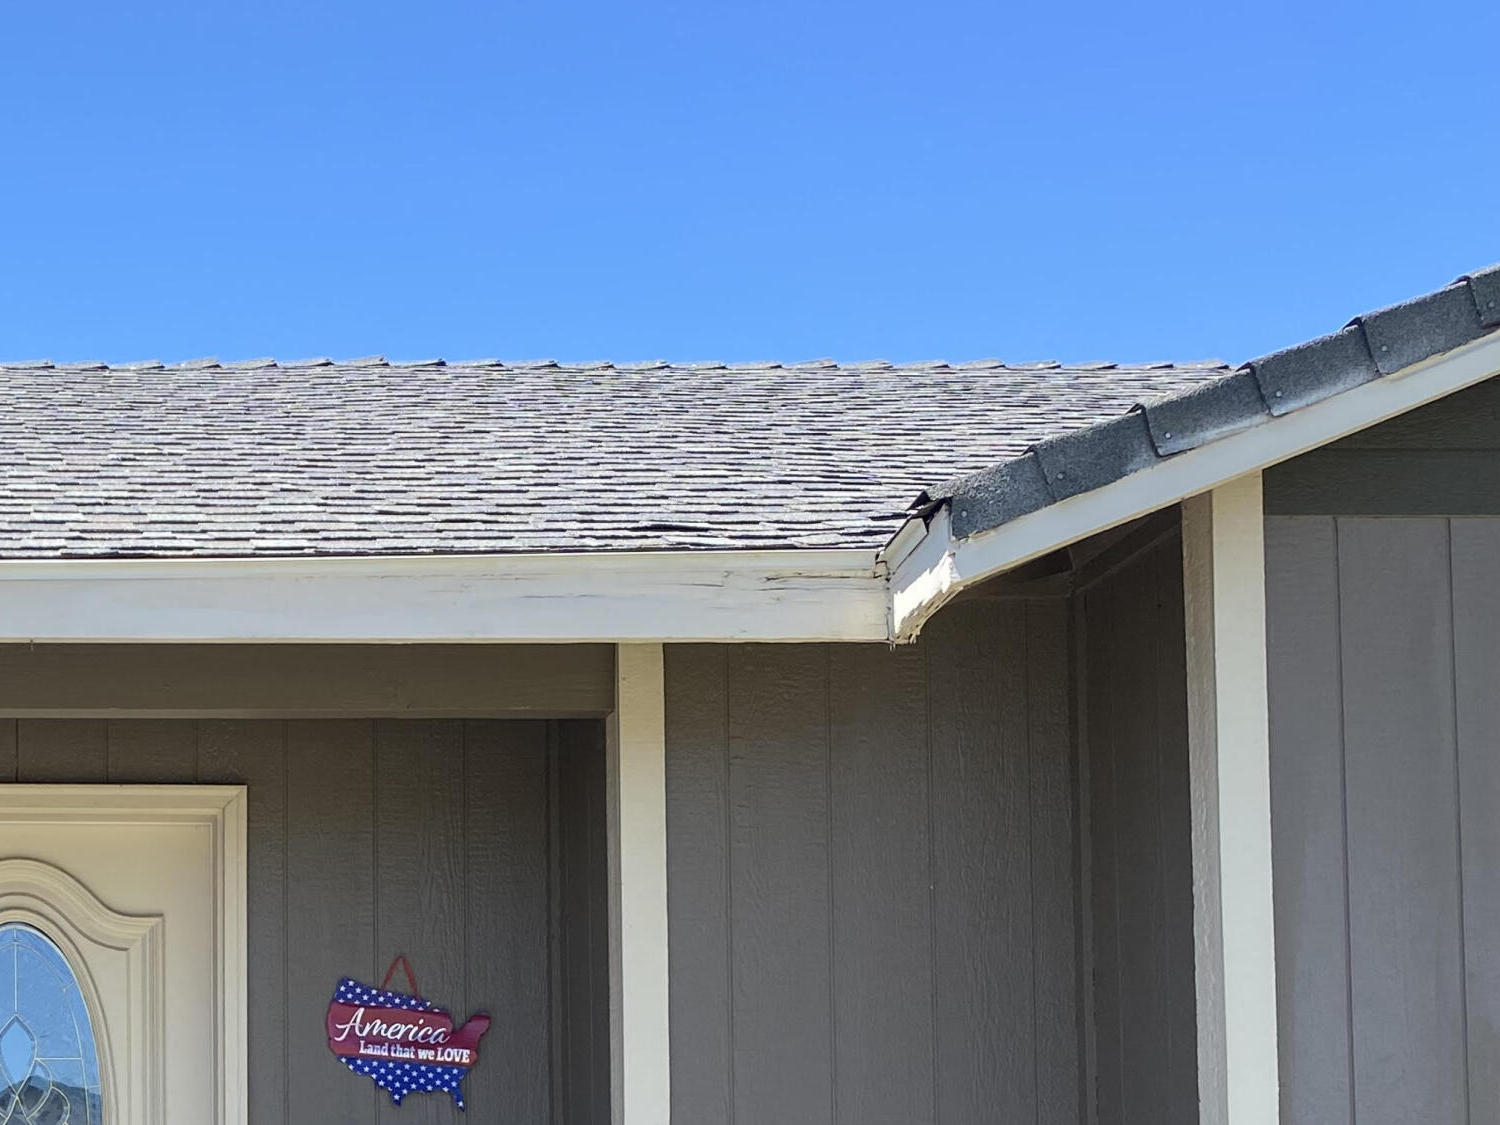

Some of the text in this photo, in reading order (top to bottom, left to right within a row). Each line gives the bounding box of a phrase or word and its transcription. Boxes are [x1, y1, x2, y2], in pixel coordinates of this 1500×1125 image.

[334, 1007, 450, 1044] America
[359, 1040, 471, 1063] Land that we LOVE
